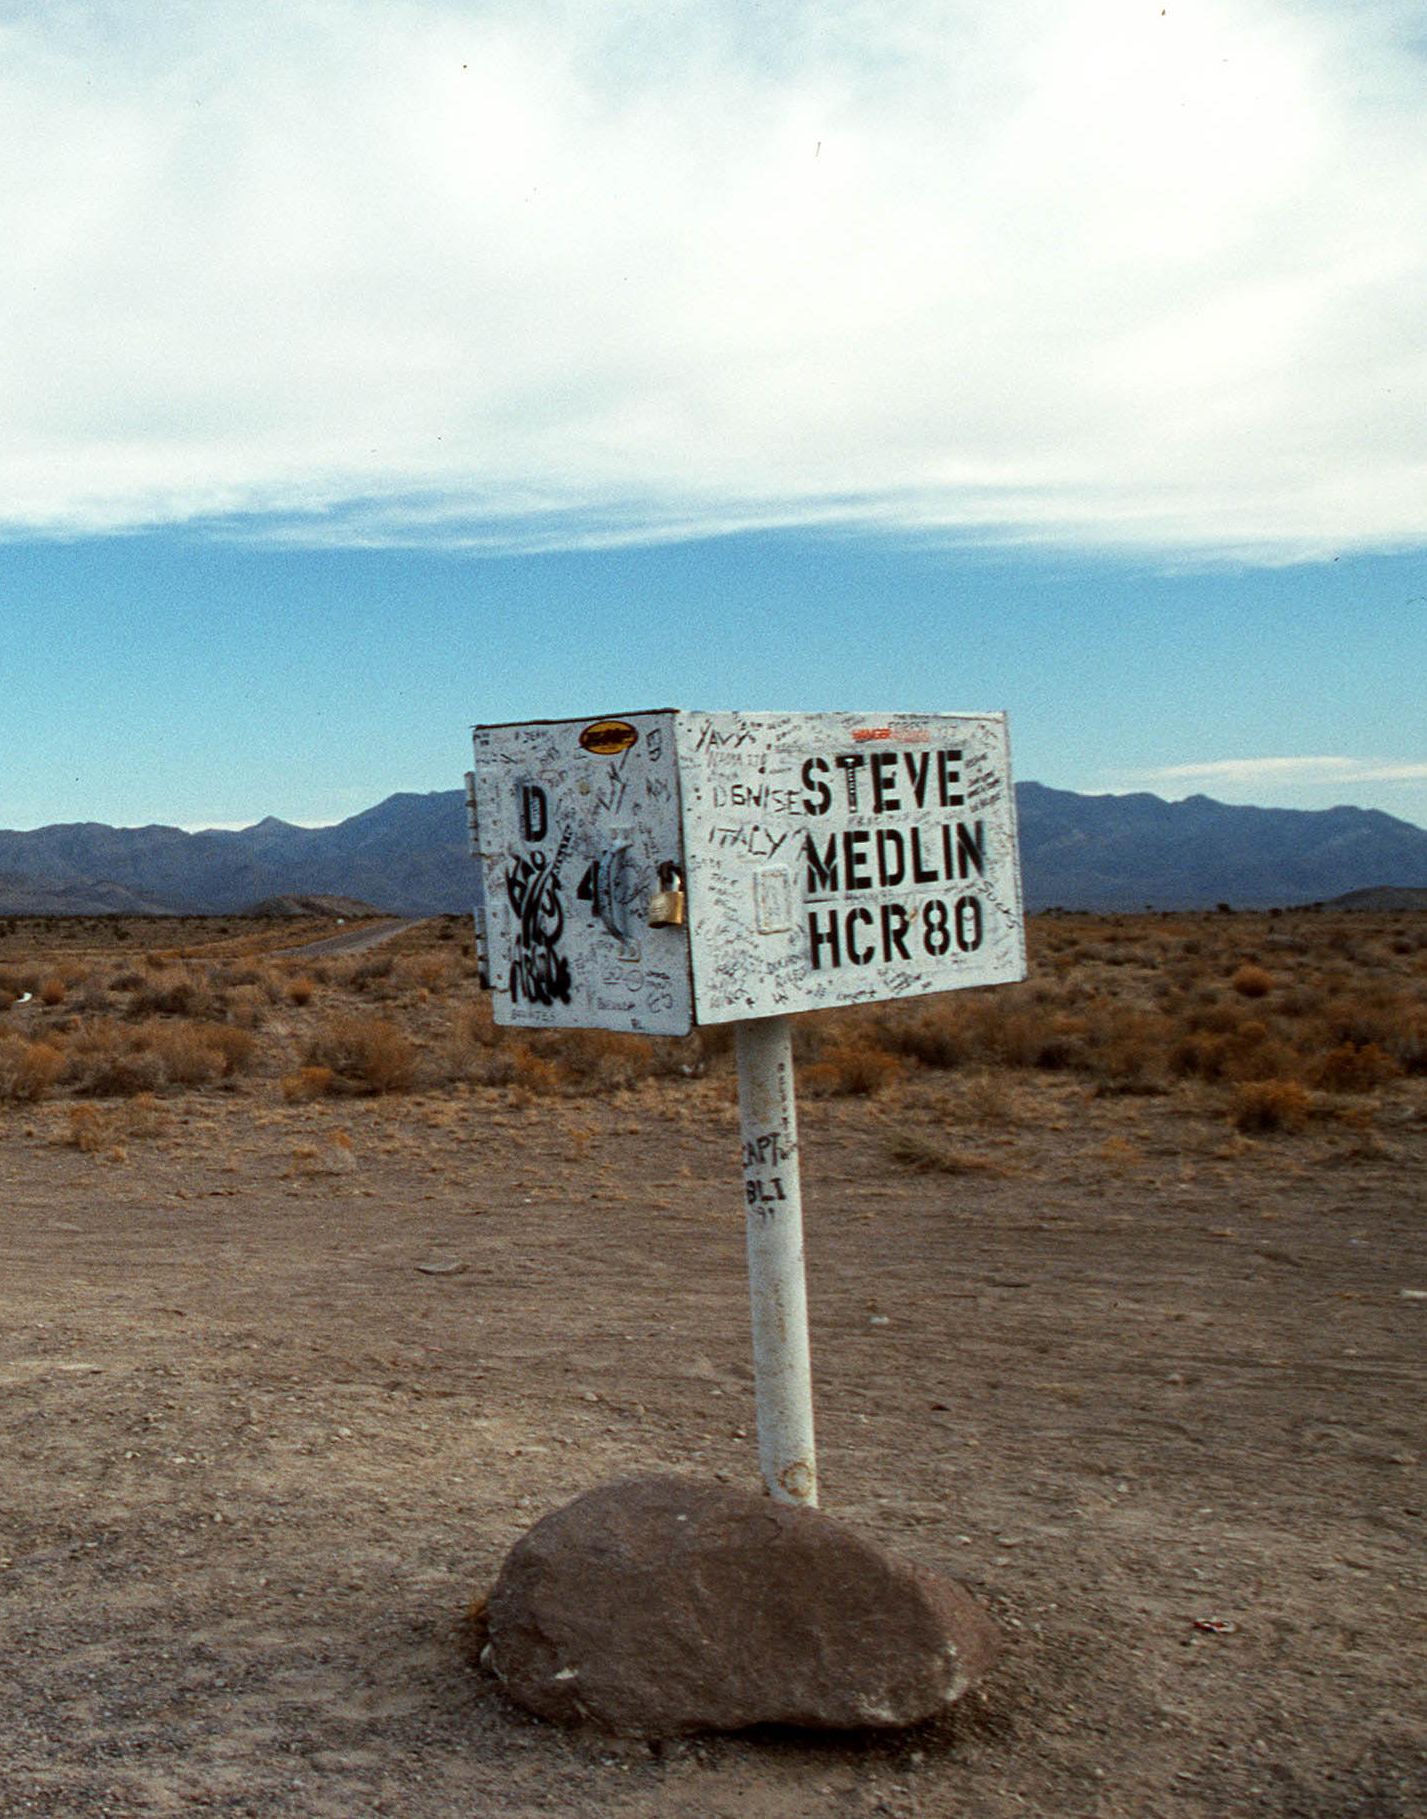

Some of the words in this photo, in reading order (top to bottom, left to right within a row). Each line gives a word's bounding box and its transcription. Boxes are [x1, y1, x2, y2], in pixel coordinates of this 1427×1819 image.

[801, 750, 964, 816] STEVE
[709, 825, 789, 859] ITALY
[806, 820, 985, 894] MEDLIN
